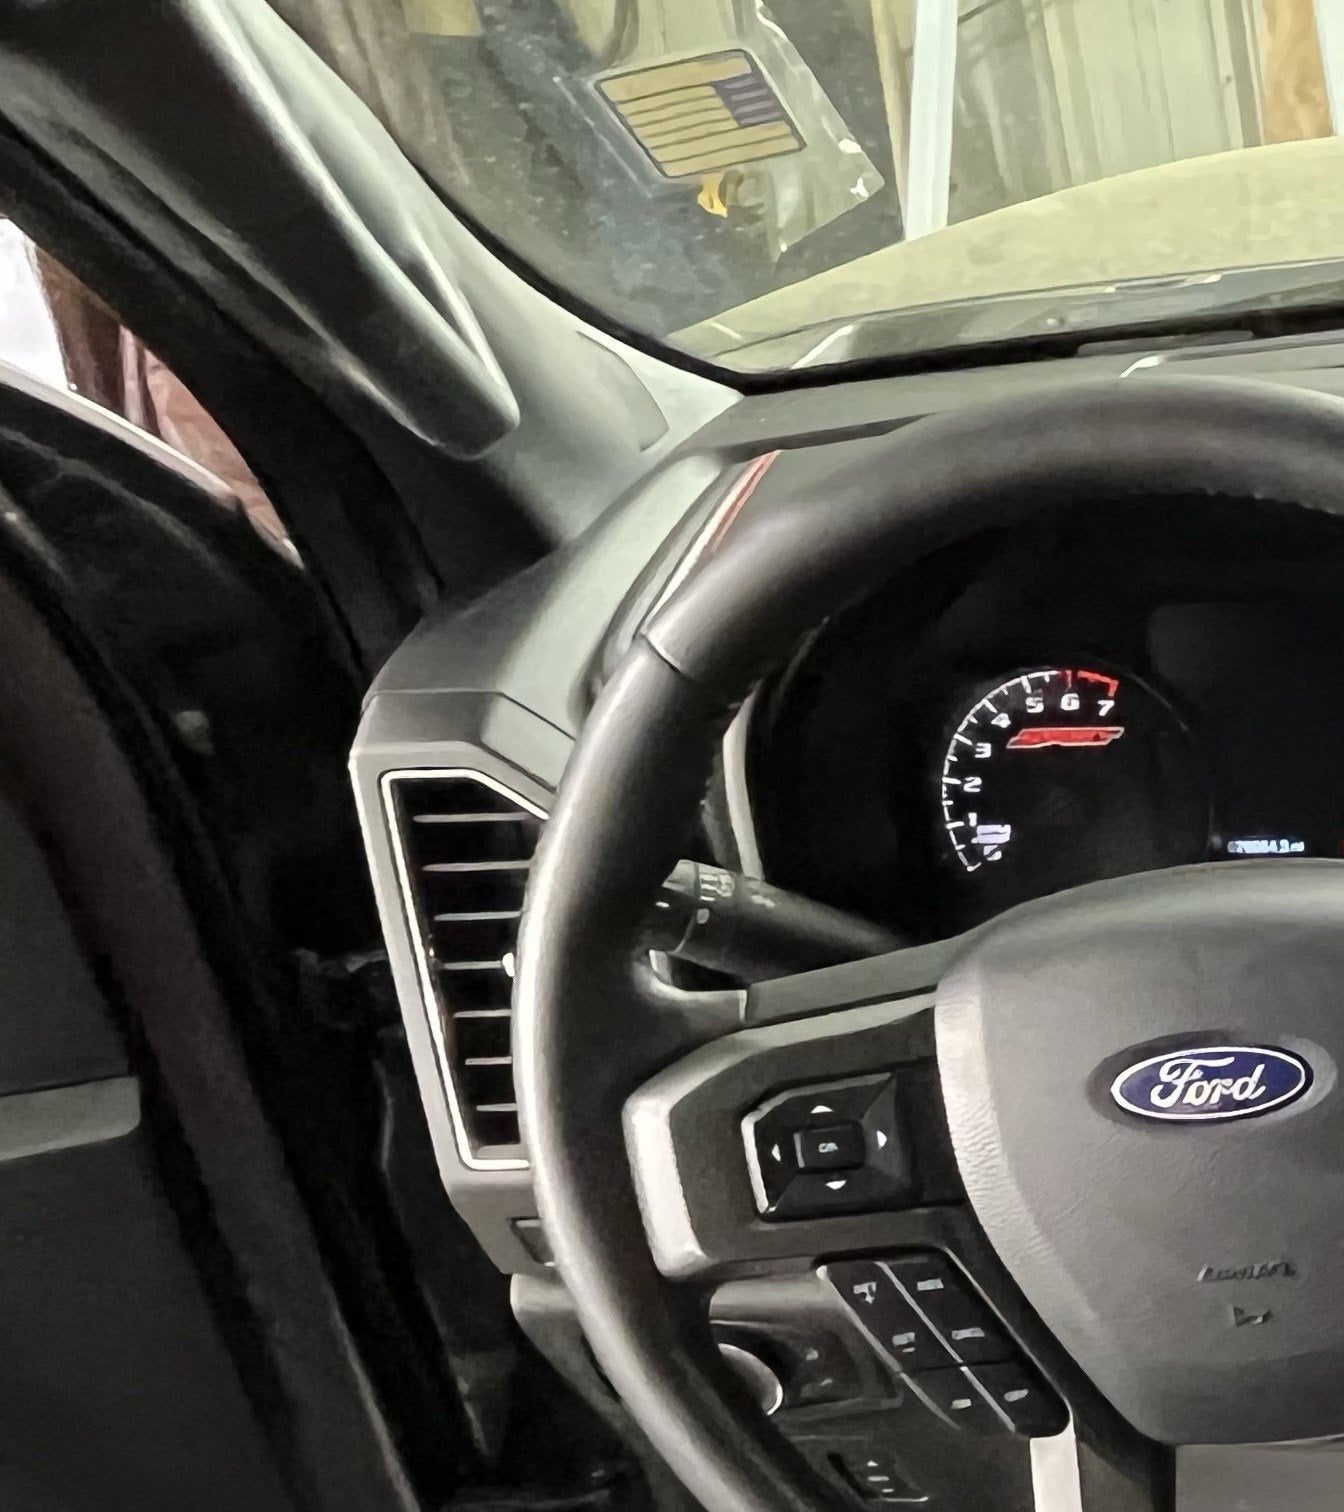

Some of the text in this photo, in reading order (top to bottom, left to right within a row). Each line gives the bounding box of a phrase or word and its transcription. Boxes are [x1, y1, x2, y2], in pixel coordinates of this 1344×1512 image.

[1097, 699, 1115, 717] 7
[974, 742, 992, 759] 3
[963, 776, 982, 793] 2
[1151, 1057, 1266, 1108] Ford
